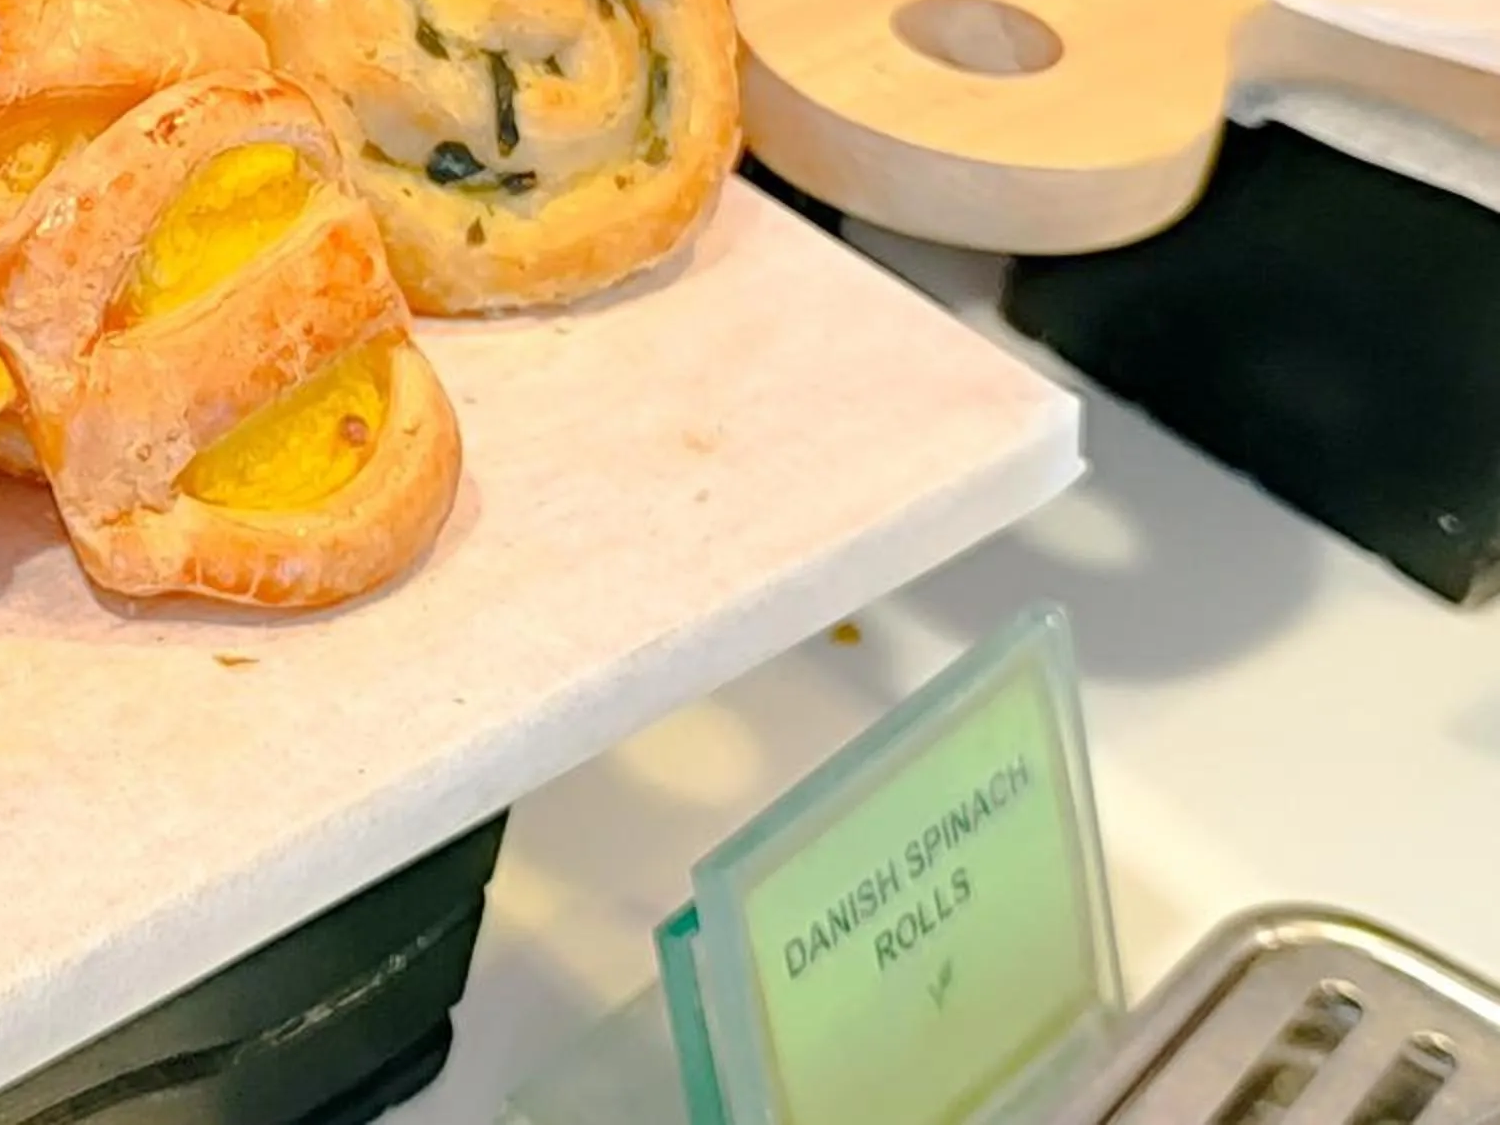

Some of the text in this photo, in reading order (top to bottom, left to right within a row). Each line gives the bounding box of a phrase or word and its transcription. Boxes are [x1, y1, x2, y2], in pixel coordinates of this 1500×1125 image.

[784, 753, 1030, 980] DANISH SPINACH
[874, 867, 972, 971] ROLLS
